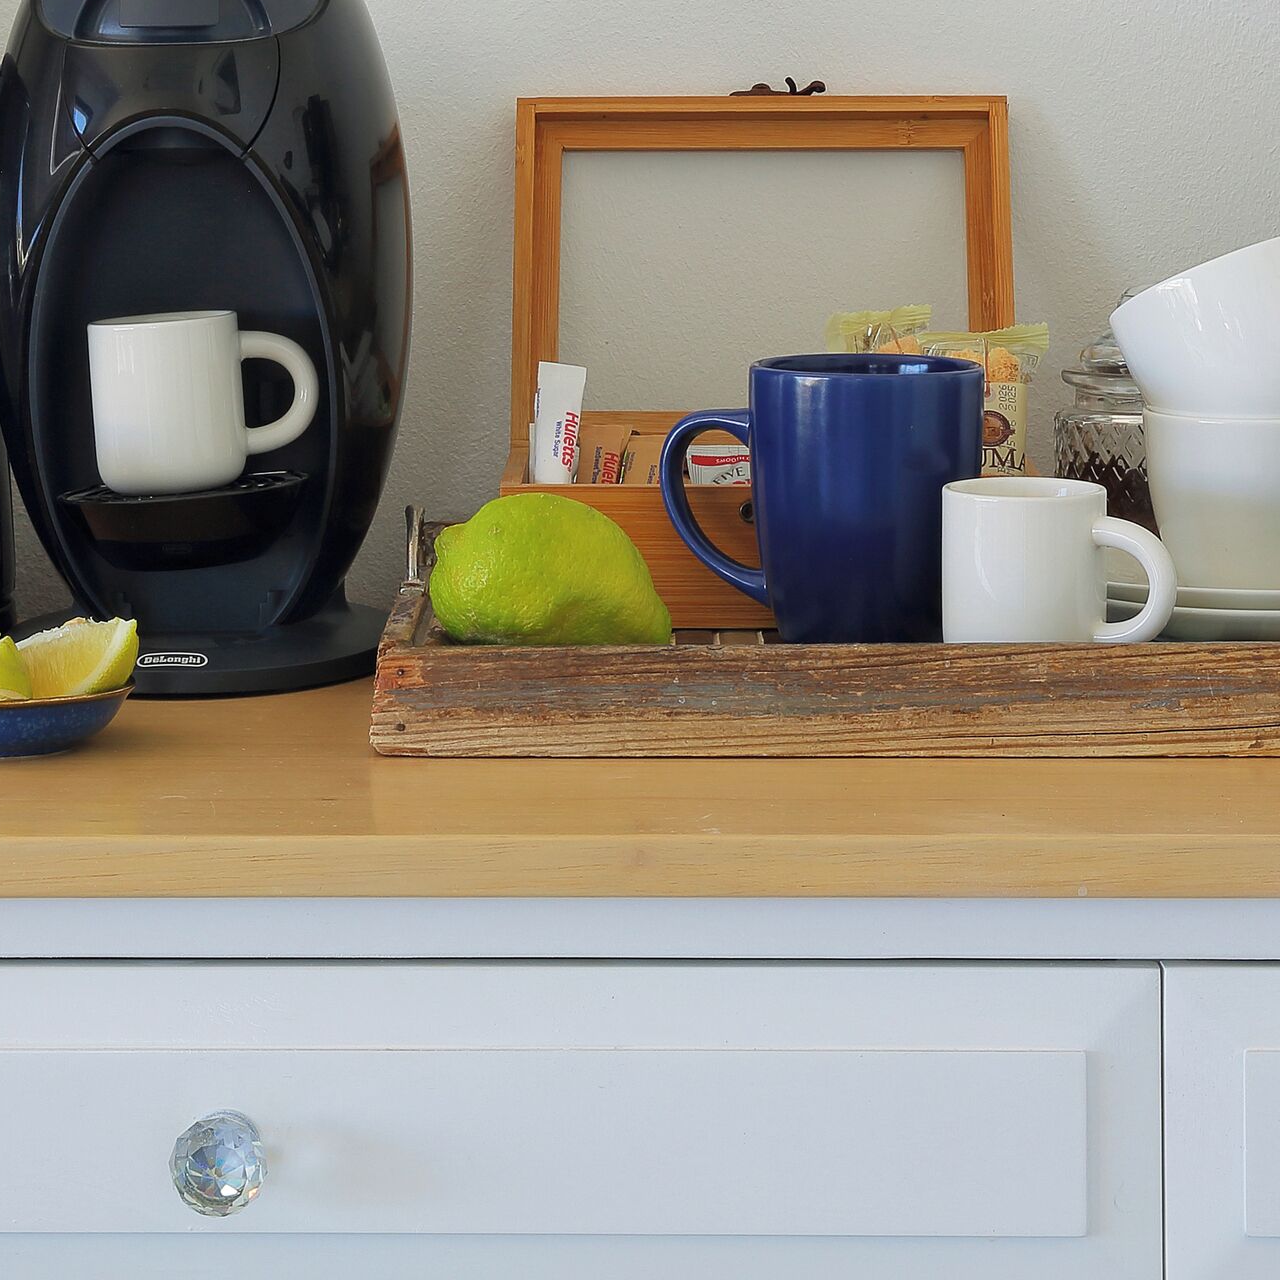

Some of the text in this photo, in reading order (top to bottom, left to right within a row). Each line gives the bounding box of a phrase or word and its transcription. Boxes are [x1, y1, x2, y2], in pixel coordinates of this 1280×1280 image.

[998, 384, 1008, 411] 2026
[1007, 385, 1017, 412] 2025
[552, 439, 562, 458] Sugar
[561, 411, 580, 468] Huletts
[601, 451, 619, 484] Hulet
